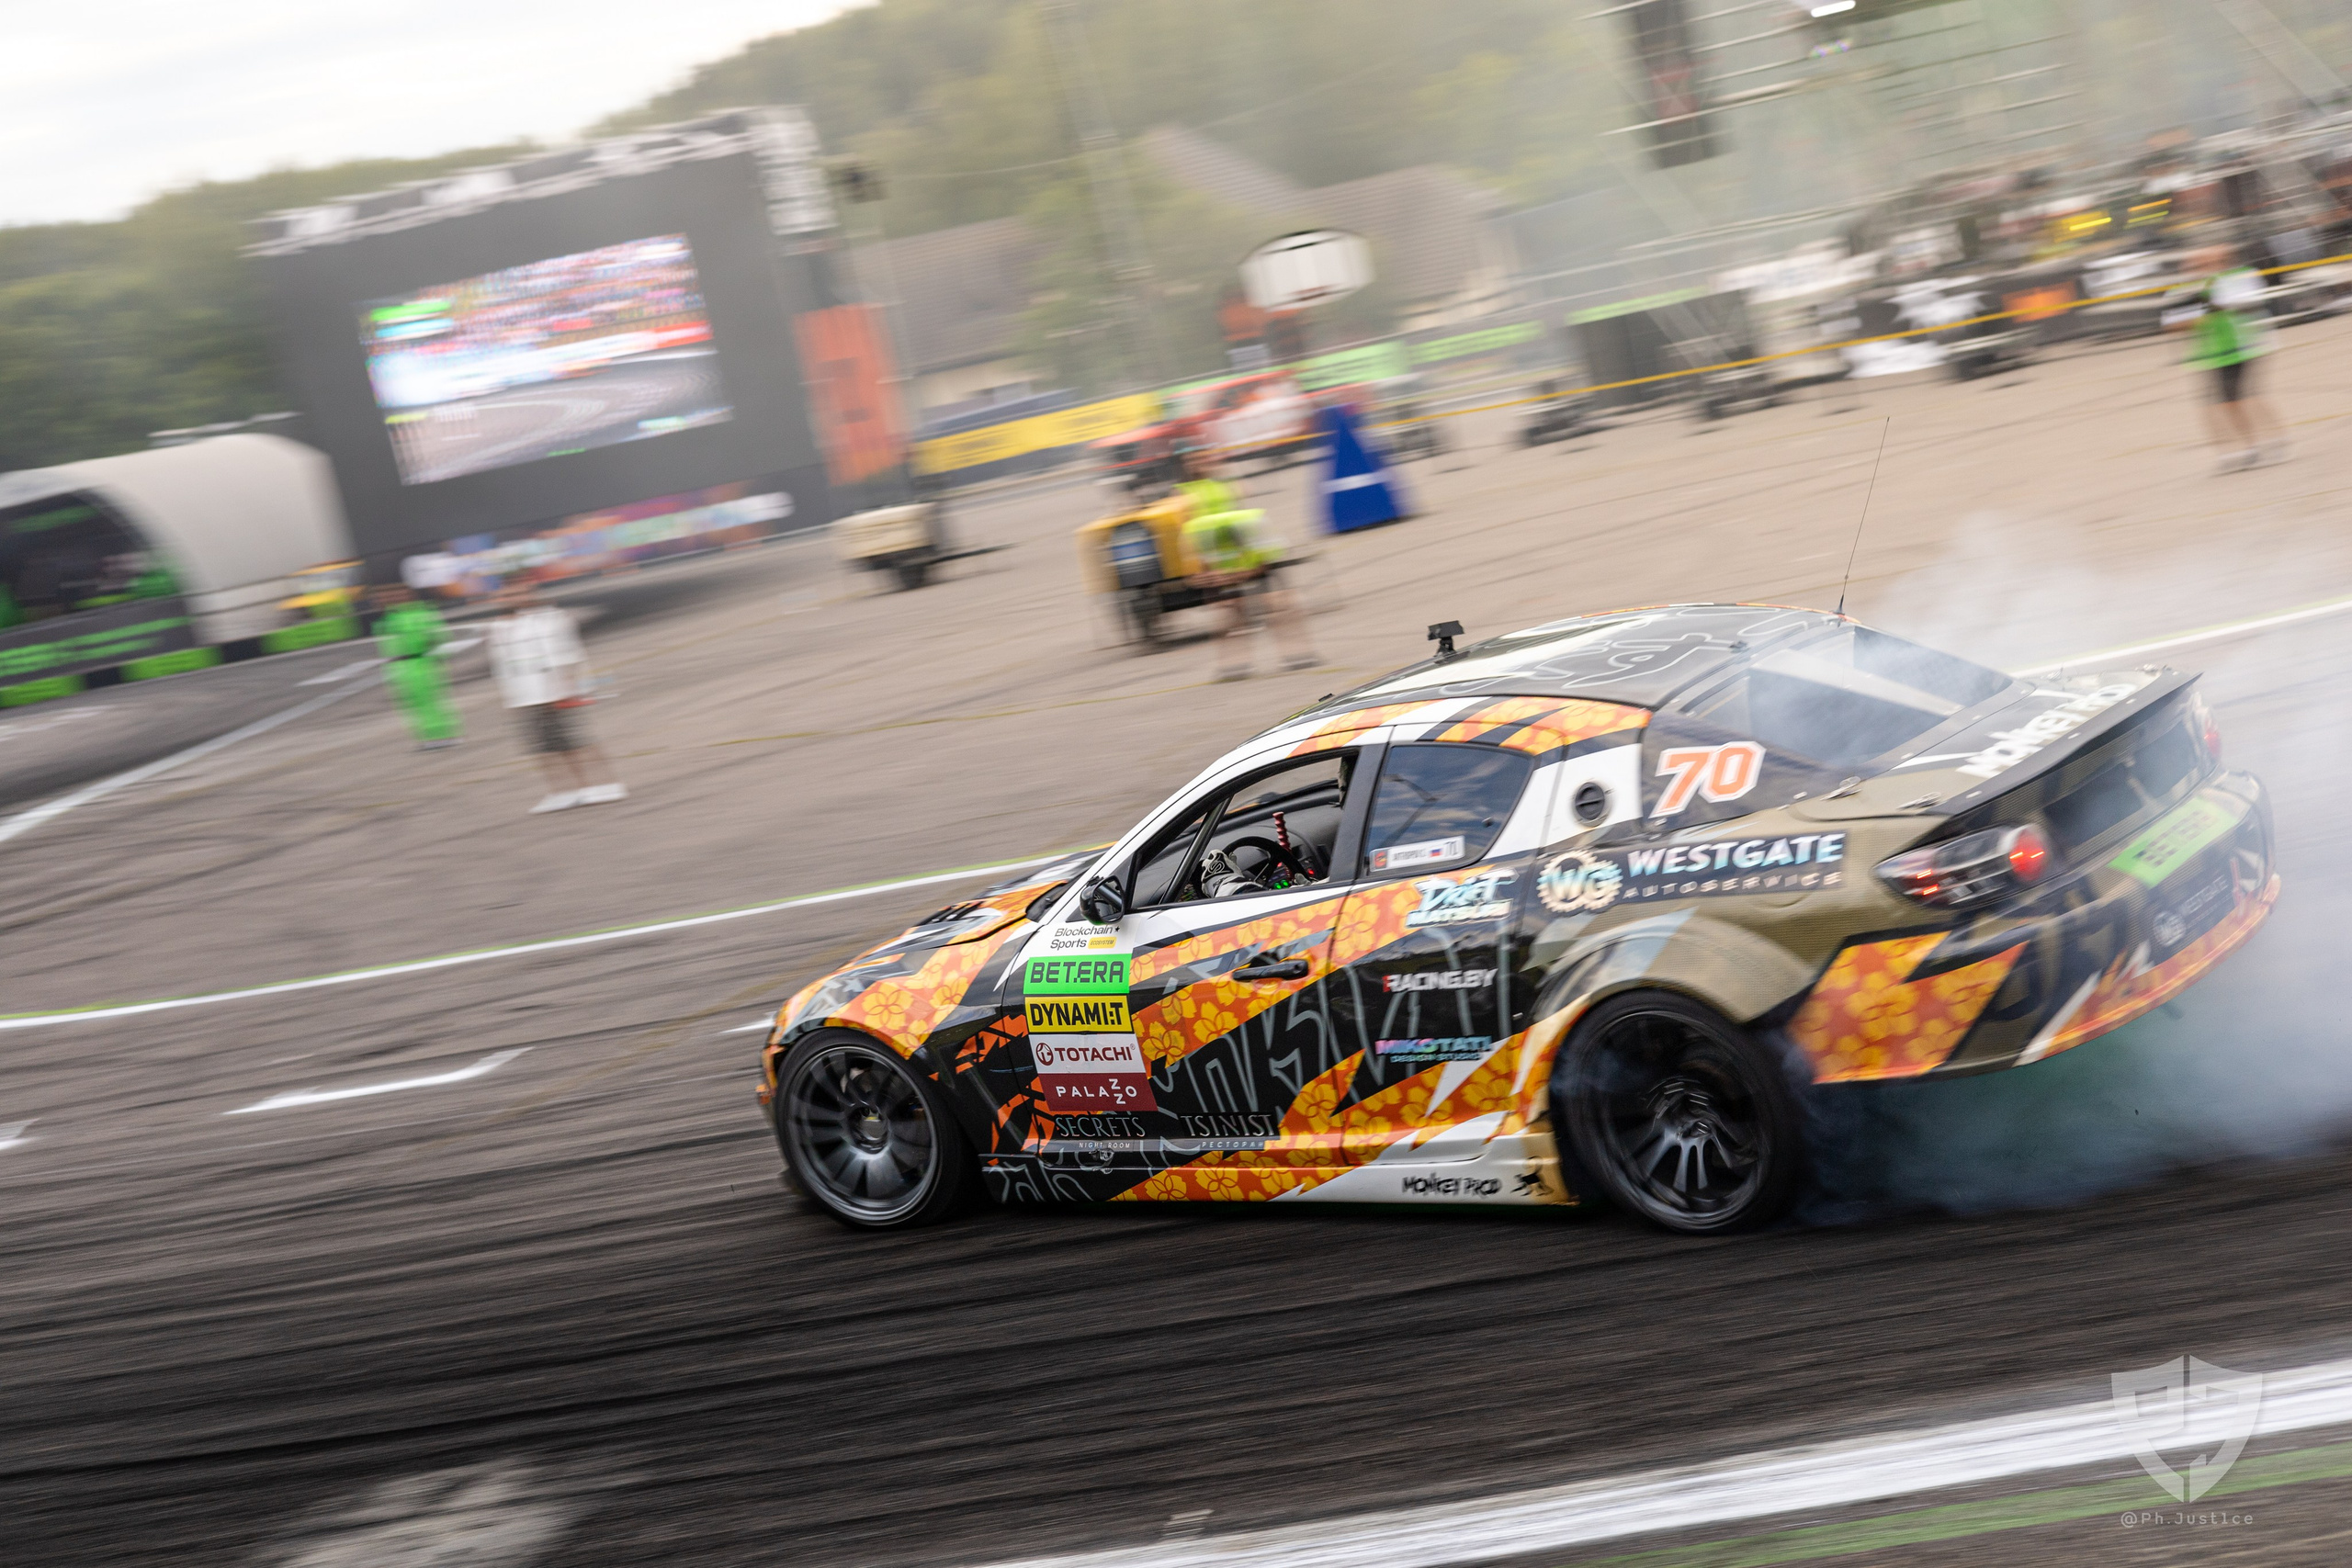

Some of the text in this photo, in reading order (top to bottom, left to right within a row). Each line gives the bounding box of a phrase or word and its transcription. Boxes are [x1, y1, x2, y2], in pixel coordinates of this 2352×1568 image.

[1650, 740, 1767, 818] 70
[1628, 833, 1845, 877] WESTGATE
[1623, 872, 1842, 900] AUTOSERVICE
[1055, 925, 1114, 938] Blockchain
[1050, 938, 1088, 951] Sports
[1056, 1078, 1137, 1104] PALAZZO
[1055, 1116, 1147, 1138] SECRETS
[1180, 1114, 1276, 1137] TSINIST
